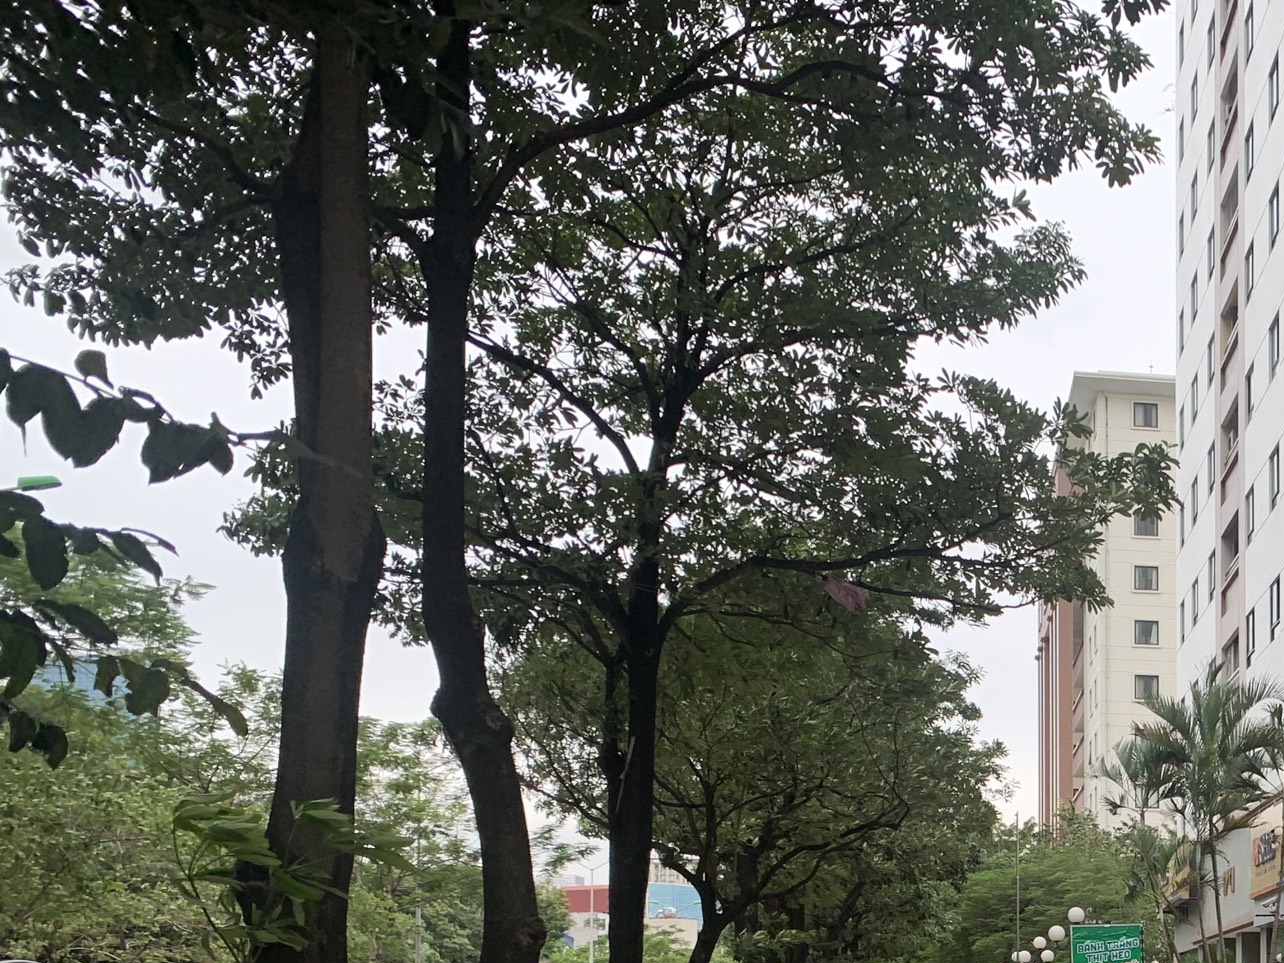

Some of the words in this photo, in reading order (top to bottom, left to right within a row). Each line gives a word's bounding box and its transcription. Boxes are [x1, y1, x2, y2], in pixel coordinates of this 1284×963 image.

[1077, 940, 1105, 954] BÁNH
[1106, 936, 1139, 950] TRÁNG
[1086, 952, 1109, 963] THỊT
[1111, 950, 1131, 961] HEO
